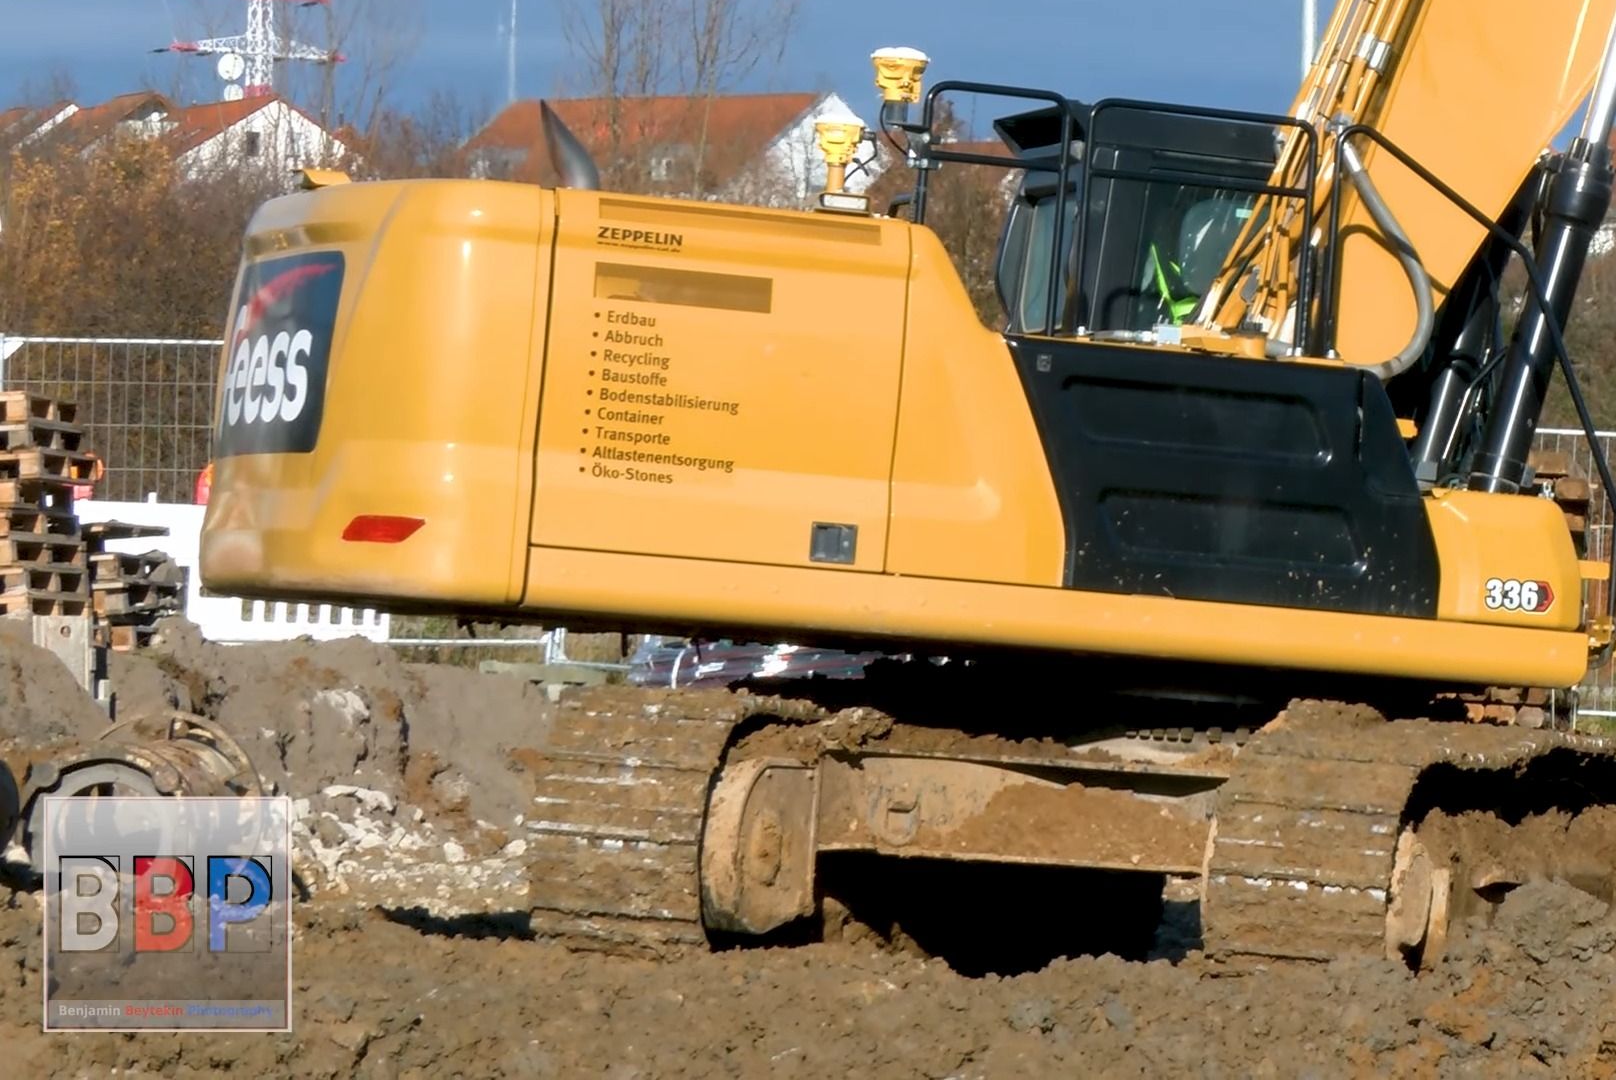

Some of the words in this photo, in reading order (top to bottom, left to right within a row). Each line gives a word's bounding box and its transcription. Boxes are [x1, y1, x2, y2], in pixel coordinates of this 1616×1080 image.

[597, 225, 683, 247] ZEPPELIN
[607, 311, 657, 328] Erdbau
[604, 330, 664, 348] Abbruch
[603, 349, 671, 370] Recycling
[601, 368, 668, 387] Baustoffe
[599, 387, 740, 416] Bodenstabilisierung
[597, 407, 665, 425] Container
[595, 426, 671, 445] Transporte
[592, 445, 735, 473] Altlastenentsorgung
[591, 462, 674, 484] Öko-Stones
[1484, 576, 1540, 612] 336
